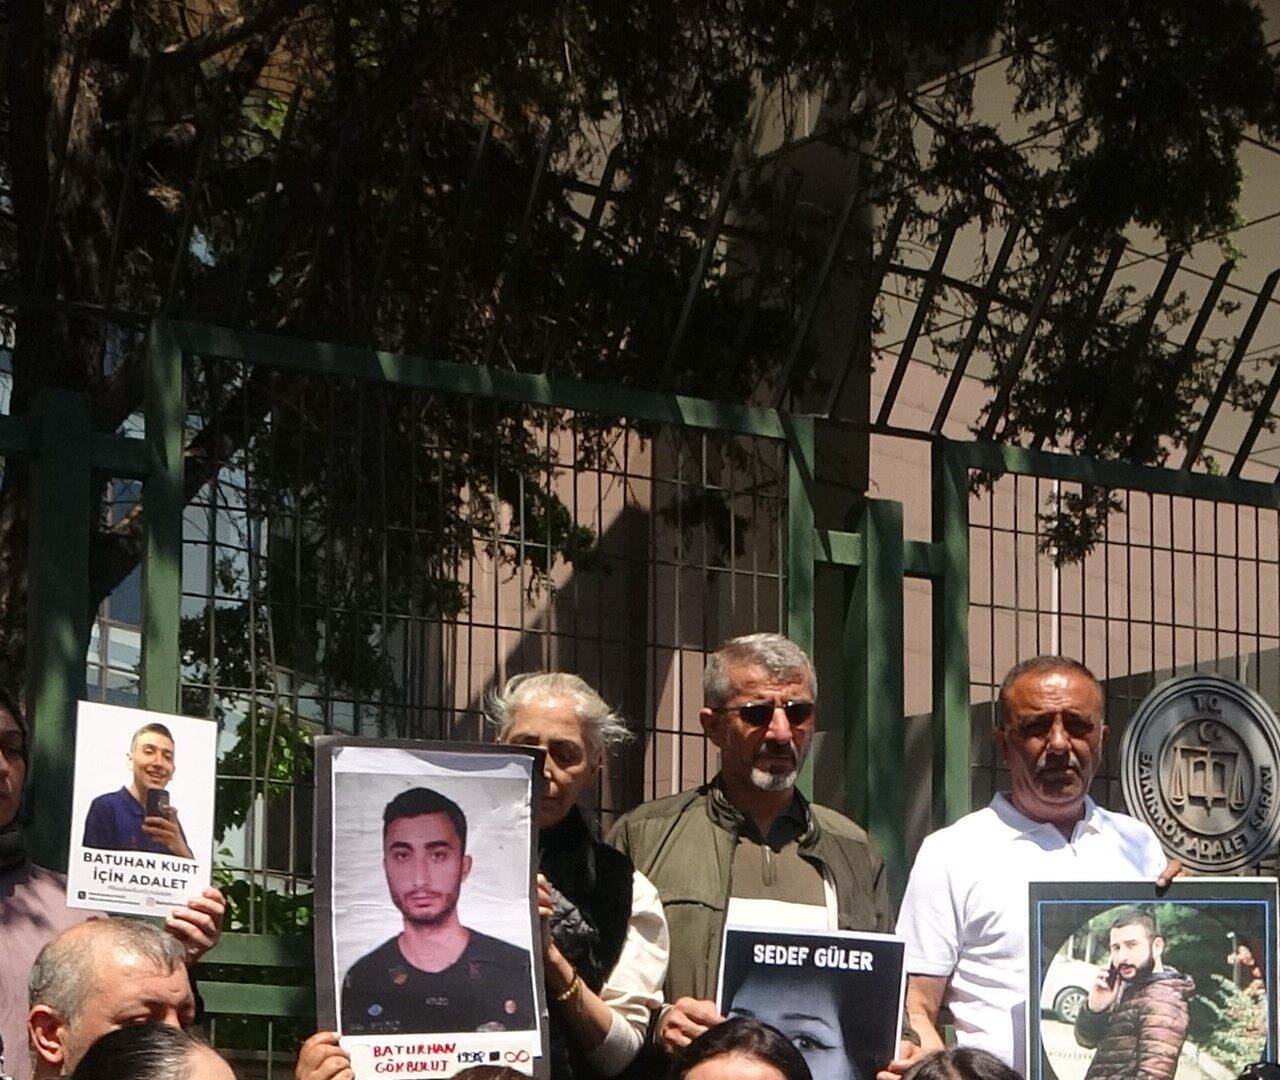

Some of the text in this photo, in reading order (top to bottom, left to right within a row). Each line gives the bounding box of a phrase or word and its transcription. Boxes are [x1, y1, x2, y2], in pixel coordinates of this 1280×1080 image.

[83, 852, 199, 875] BATUHAN KURT
[93, 867, 188, 890] İÇİN ADALET
[753, 944, 873, 971] SEDEF GÜLER
